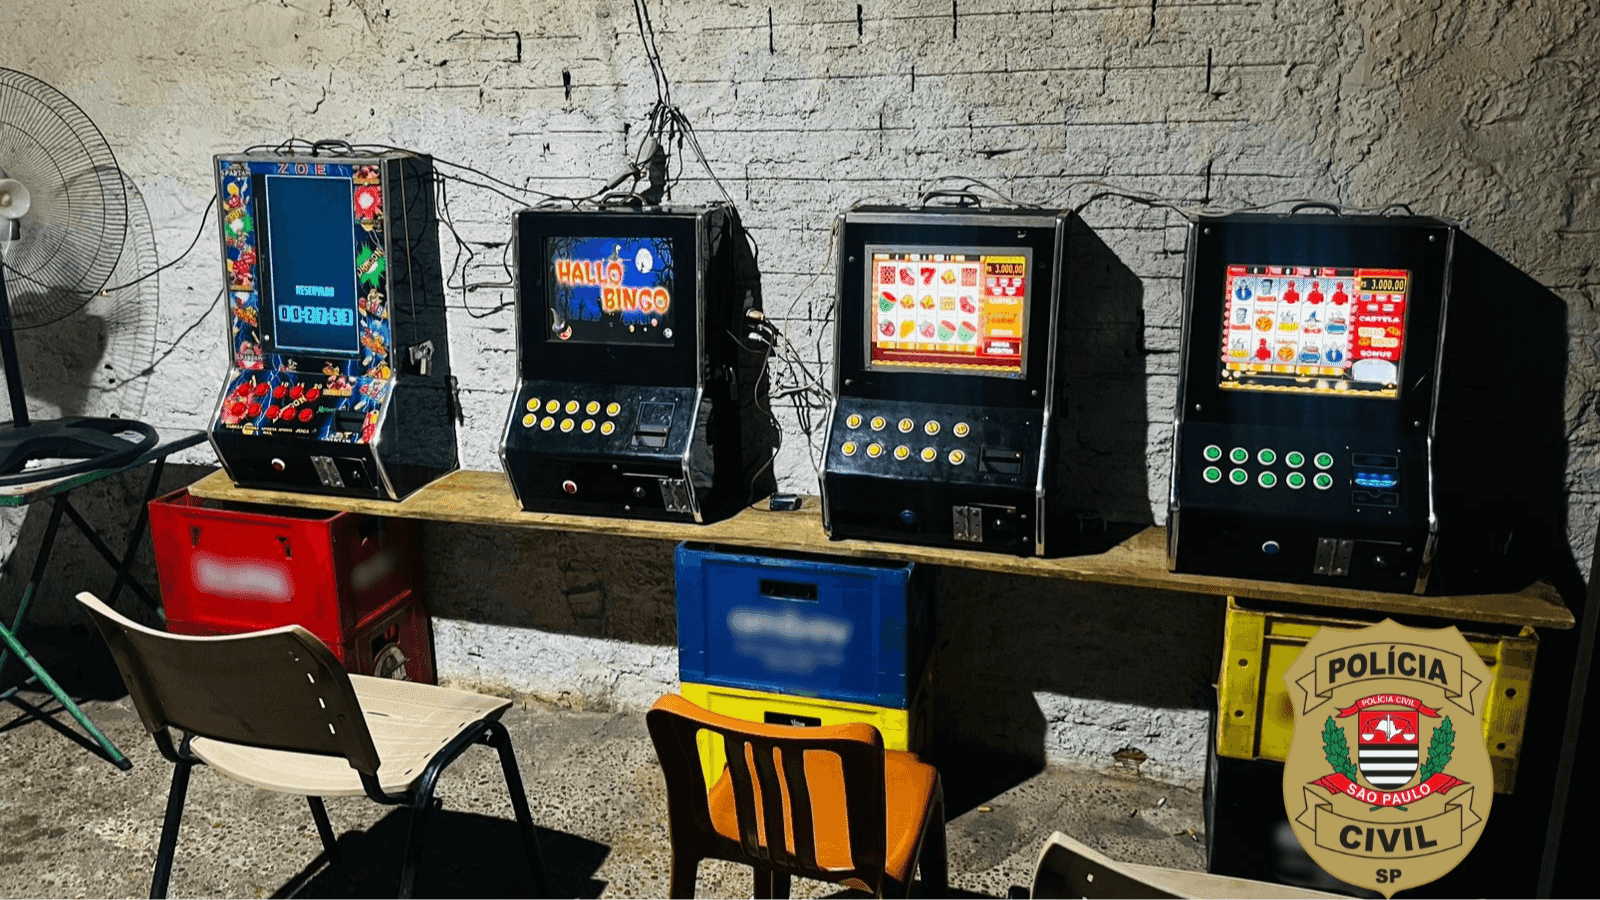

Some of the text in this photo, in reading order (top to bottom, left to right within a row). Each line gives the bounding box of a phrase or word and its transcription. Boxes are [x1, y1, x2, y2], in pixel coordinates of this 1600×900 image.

[278, 163, 326, 175] ZOE
[556, 260, 623, 286] HALLO
[602, 286, 670, 313] BINGO
